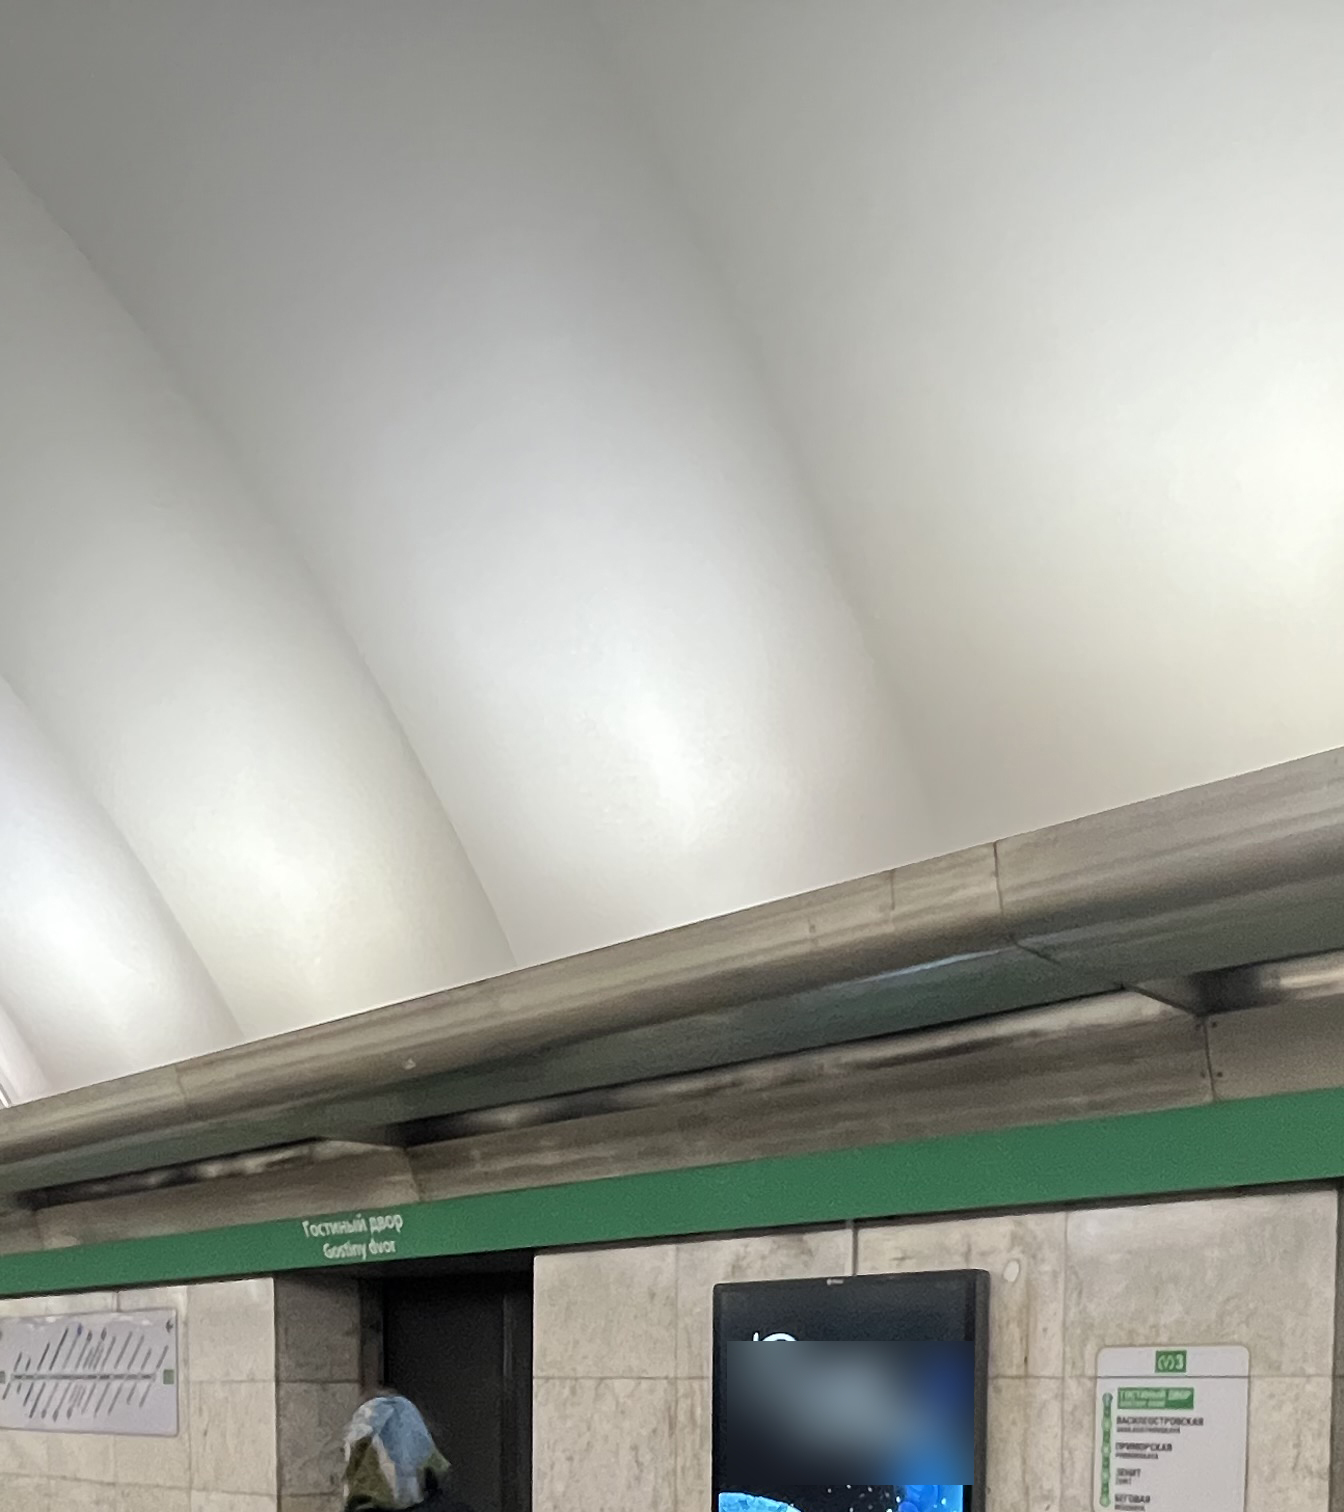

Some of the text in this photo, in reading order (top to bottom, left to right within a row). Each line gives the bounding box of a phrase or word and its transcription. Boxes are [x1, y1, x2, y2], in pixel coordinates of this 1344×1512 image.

[301, 1213, 404, 1238] Гостиный двор
[322, 1238, 396, 1260] Gostiny dvor
